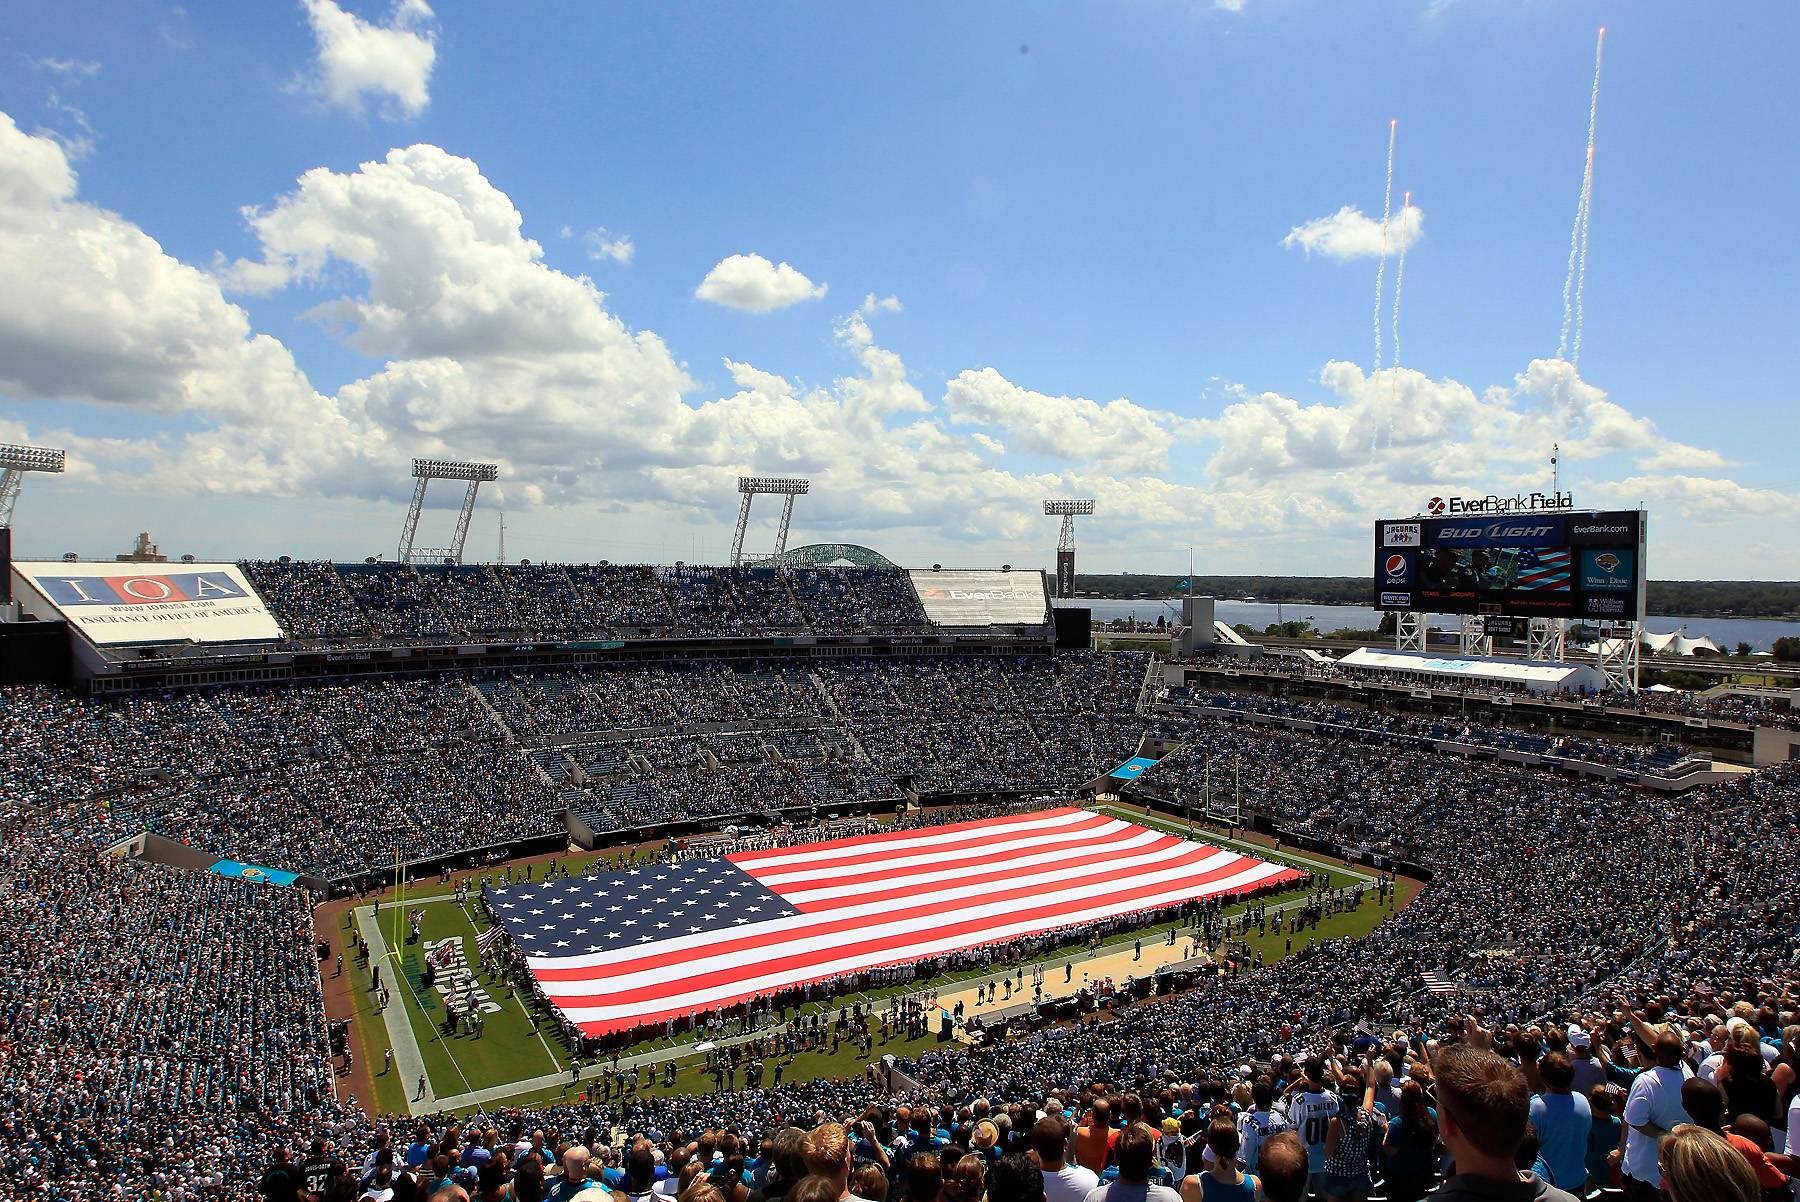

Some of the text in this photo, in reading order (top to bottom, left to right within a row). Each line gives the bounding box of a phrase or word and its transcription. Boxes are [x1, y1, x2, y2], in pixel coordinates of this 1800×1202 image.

[1449, 491, 1574, 513] EverBank Field
[1386, 525, 1418, 535] JAGUARS
[1438, 526, 1554, 539] BUD LIGHT
[1573, 524, 1628, 534] EverBank.com
[1386, 577, 1406, 585] pepsi
[949, 590, 1036, 600] EverBank
[79, 606, 261, 625] INSURANCE OFFICE OF AMERICA
[701, 818, 742, 829] TOUCHDOWN
[306, 1173, 328, 1192] 32
